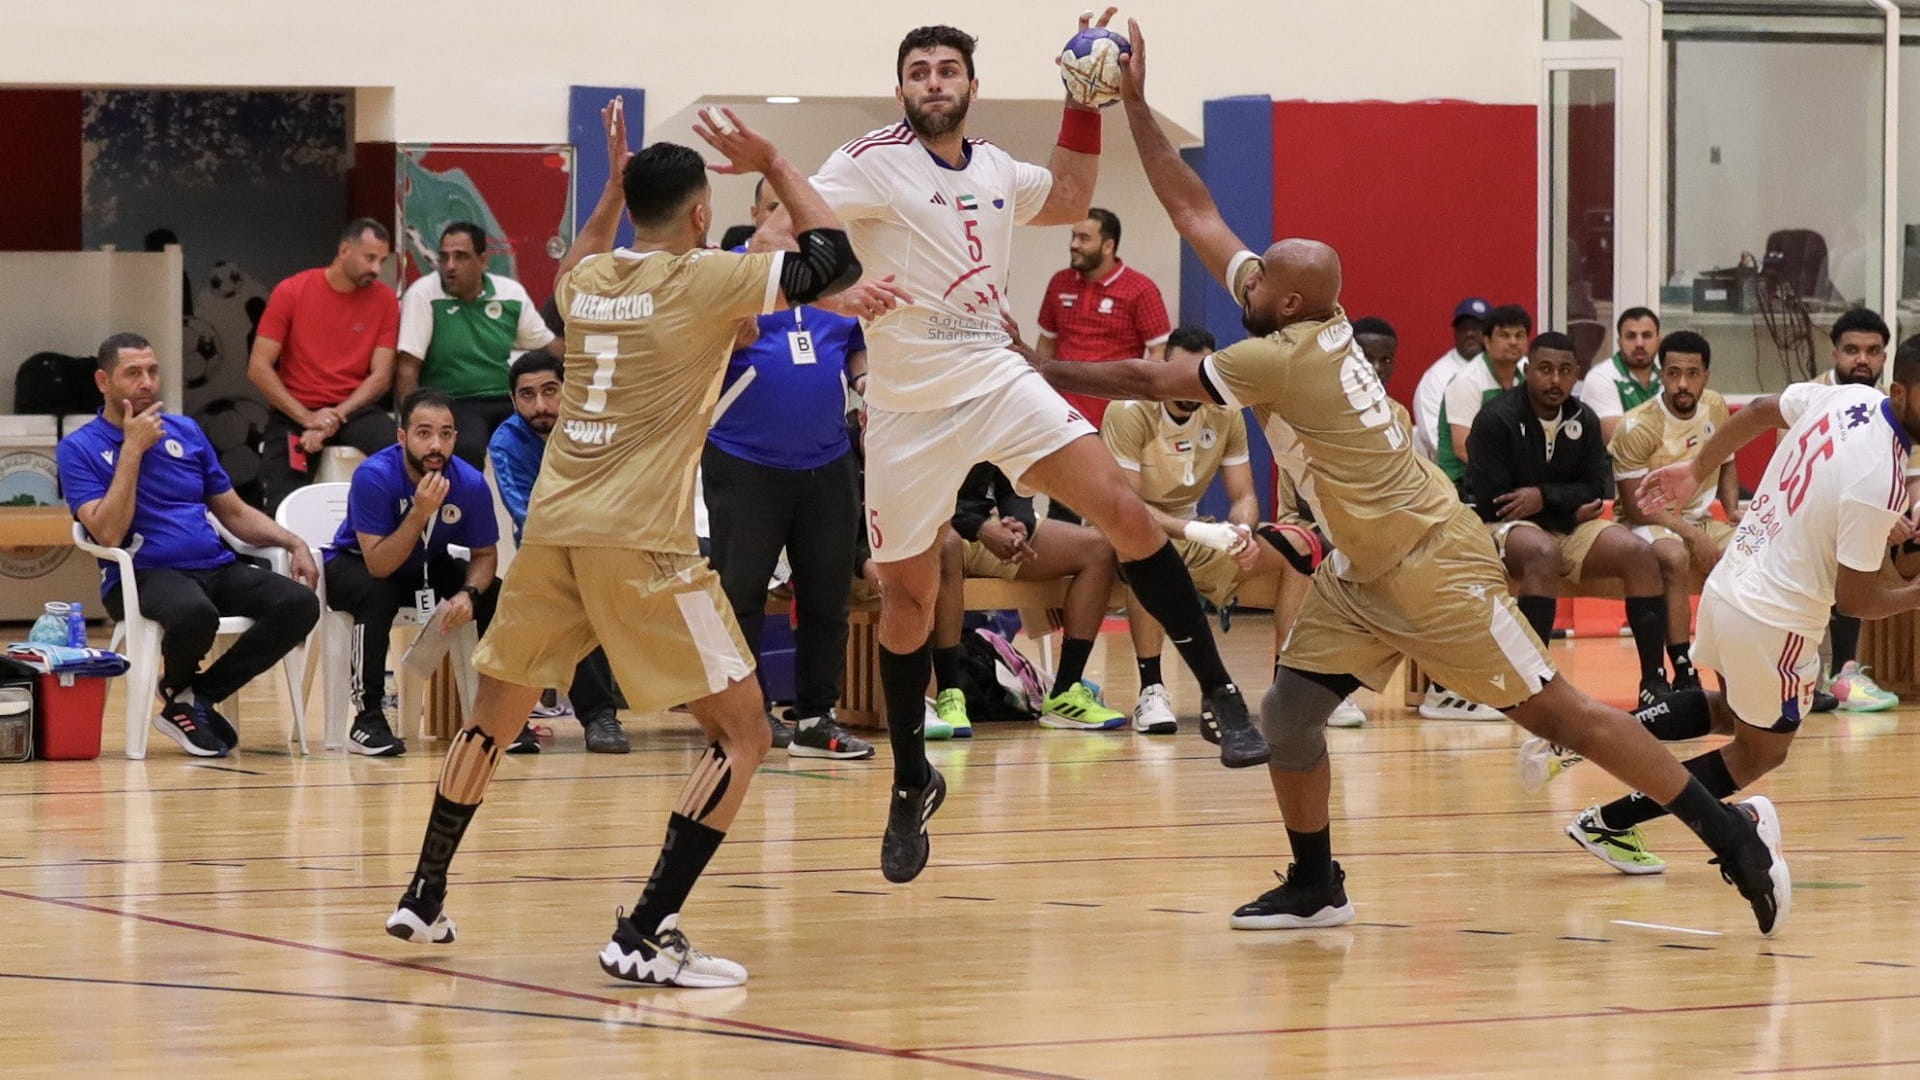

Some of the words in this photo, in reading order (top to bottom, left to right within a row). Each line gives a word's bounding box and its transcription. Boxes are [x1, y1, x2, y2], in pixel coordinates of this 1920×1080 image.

[963, 219, 983, 263] 5
[615, 292, 655, 321] CLUB
[797, 336, 810, 352] B
[582, 334, 619, 413] 7
[1778, 412, 1834, 518] 55
[420, 594, 431, 611] E
